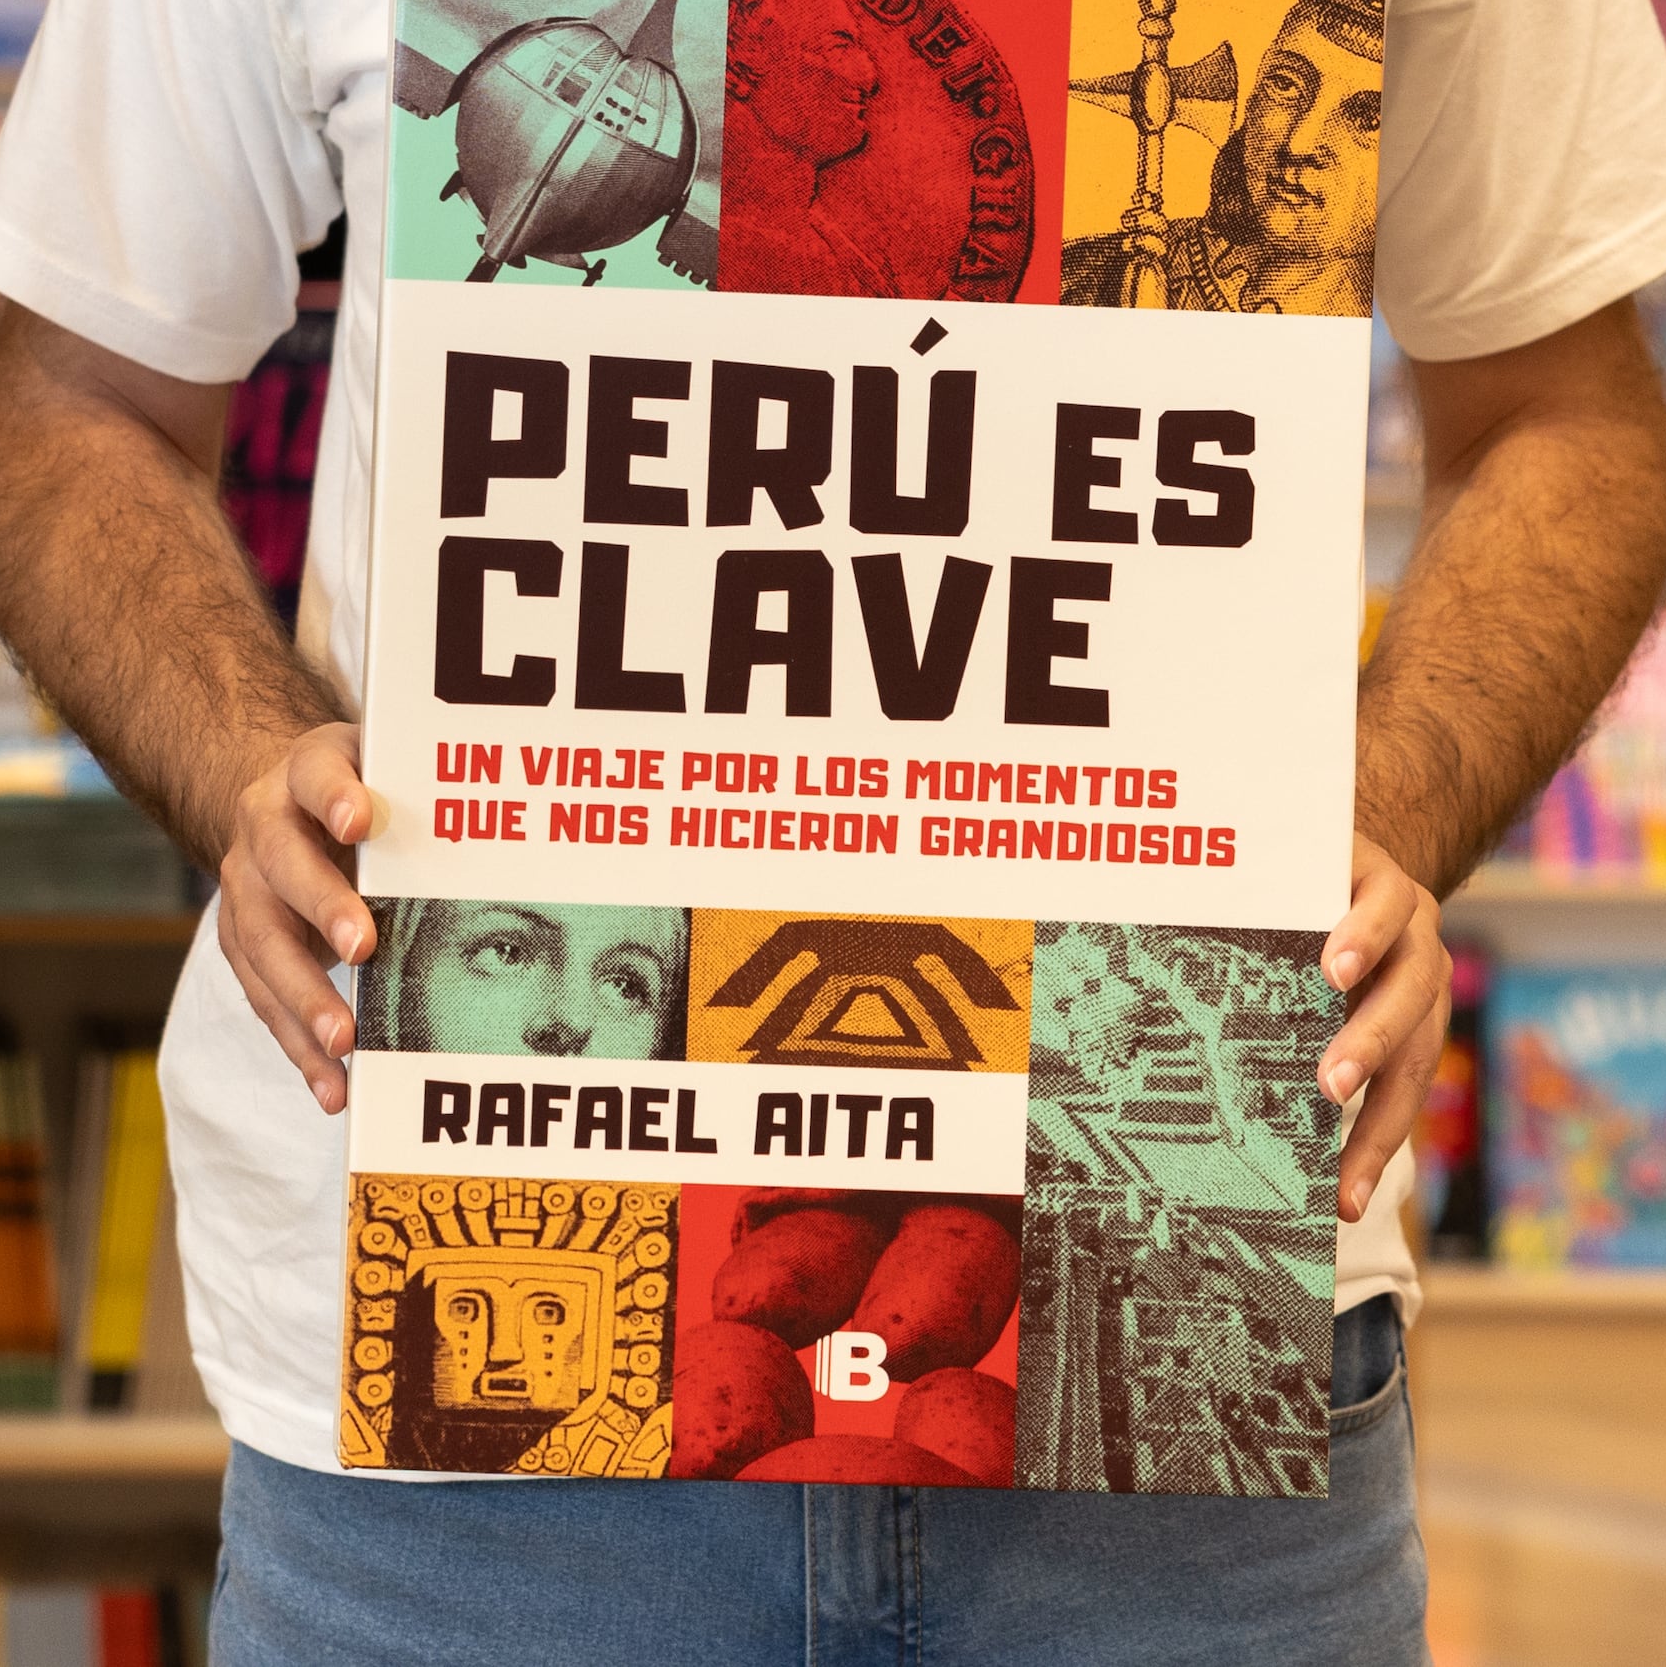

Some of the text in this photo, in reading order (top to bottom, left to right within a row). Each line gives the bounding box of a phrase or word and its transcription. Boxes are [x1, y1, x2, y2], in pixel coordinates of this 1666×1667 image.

[440, 317, 1255, 548] PERÚ ES
[434, 534, 1112, 728] CLAVE
[436, 741, 1177, 808] UN VIAJE POR LOS MOMENTOS
[433, 801, 1235, 867] QUE NOS HICIERON GRANDIOSOS
[422, 1079, 933, 1161] RAFAEL AITA
